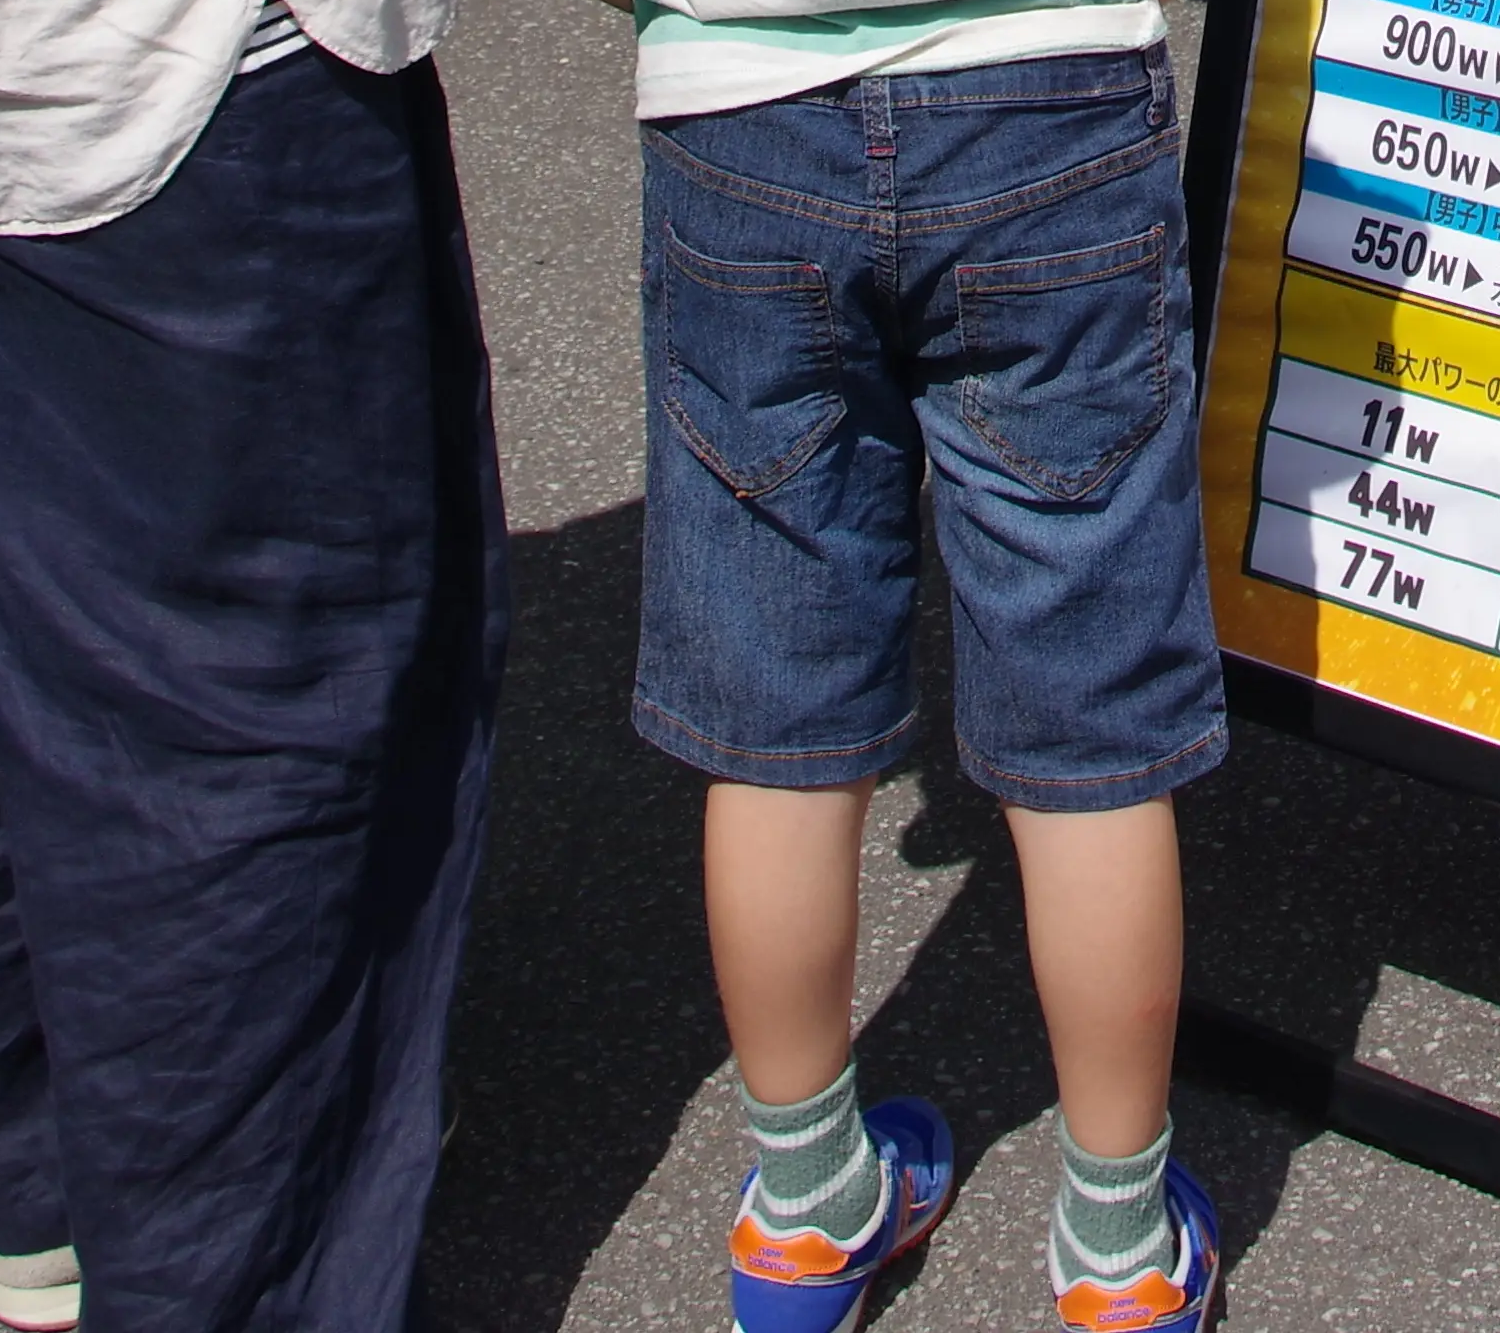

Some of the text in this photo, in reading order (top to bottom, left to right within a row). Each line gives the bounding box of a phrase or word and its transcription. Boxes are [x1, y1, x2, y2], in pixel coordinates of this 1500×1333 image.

[758, 1246, 785, 1258] new
[747, 1255, 797, 1274] balance
[1108, 1296, 1137, 1309] new
[1095, 1305, 1150, 1324] balance
